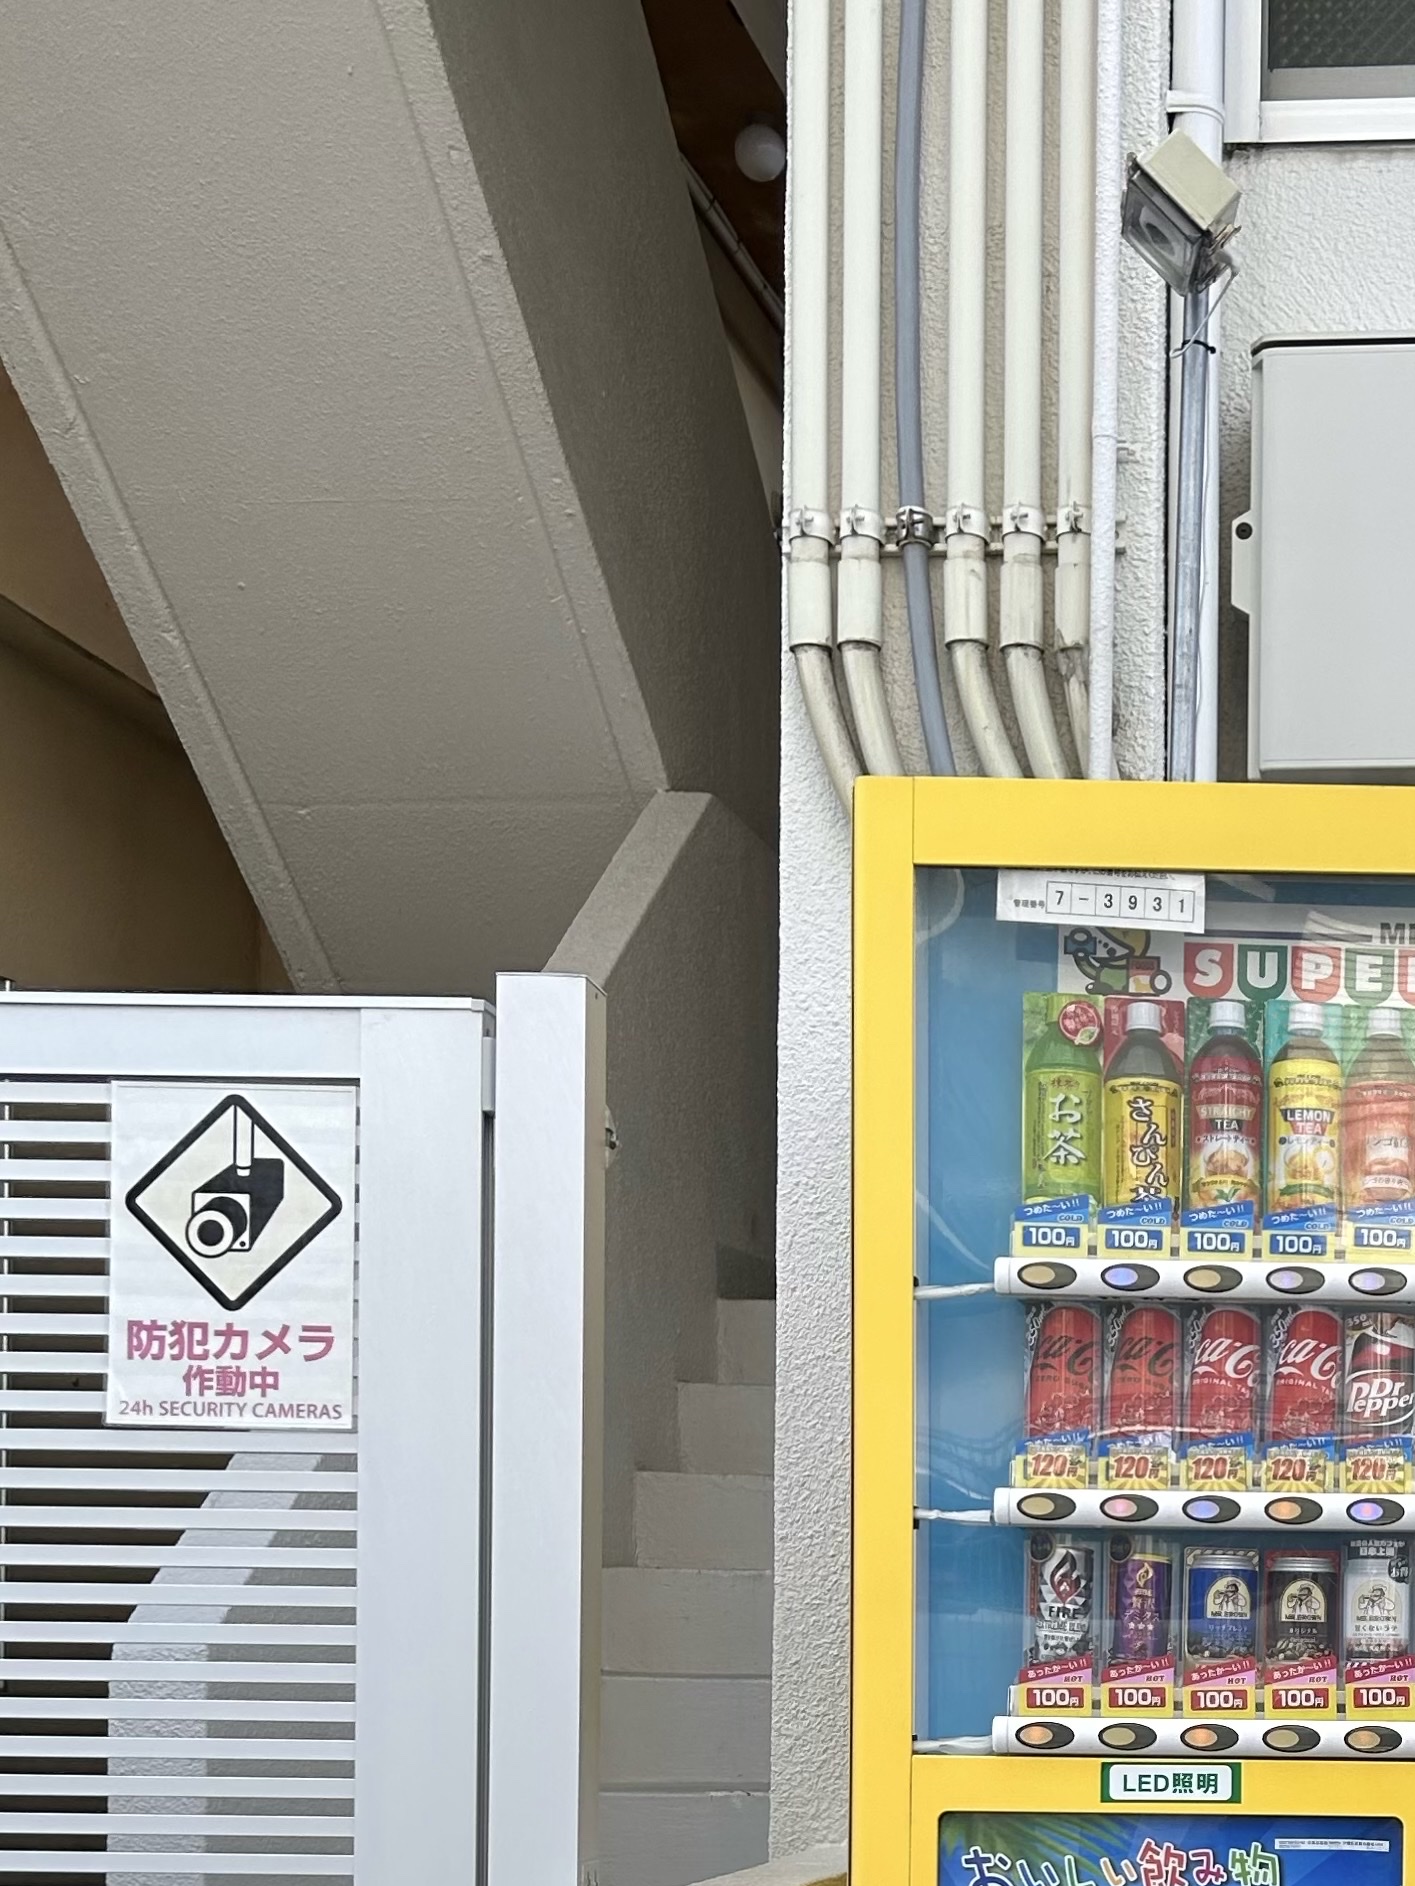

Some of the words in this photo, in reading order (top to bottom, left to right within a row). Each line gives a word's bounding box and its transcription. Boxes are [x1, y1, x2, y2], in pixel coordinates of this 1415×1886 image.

[1199, 1105, 1252, 1119] STRAIGHT
[1286, 1109, 1332, 1121] LEMON
[1043, 1093, 1086, 1165] お茶
[1214, 1119, 1239, 1131] TEA
[1294, 1123, 1322, 1134] TEA
[1127, 1096, 1170, 1202] さんぴん茶
[1058, 1213, 1084, 1224] COLD
[1140, 1216, 1167, 1226] COLD
[1223, 1219, 1248, 1229] COLD
[1305, 1221, 1331, 1231] COLD
[1389, 1216, 1415, 1226] COLD
[1028, 1227, 1076, 1248] 100円
[1111, 1229, 1159, 1249] 100円
[1193, 1232, 1241, 1253] 100円
[1275, 1234, 1323, 1255] 100円
[1359, 1228, 1406, 1249] 100円
[126, 1319, 336, 1362] 防犯カメラ
[181, 1365, 280, 1398] 作動中
[1370, 1377, 1406, 1400] Dr
[118, 1400, 154, 1417] 24h
[158, 1400, 248, 1419] SECURITY
[251, 1402, 343, 1420] CAMERAS
[1031, 1453, 1079, 1478] 120円
[1113, 1454, 1160, 1480] 120円
[1192, 1456, 1240, 1481] 120円
[1270, 1457, 1317, 1482] 120円
[1350, 1456, 1397, 1482] 120円
[1048, 1605, 1079, 1619] FIRE
[1124, 1610, 1160, 1623] デミタス
[1063, 1675, 1084, 1683] HOT
[1145, 1675, 1166, 1683] HOT
[1226, 1676, 1247, 1685] HOT
[1308, 1675, 1328, 1684] HOT
[1389, 1674, 1410, 1683] HOT
[1032, 1688, 1080, 1708] 100円
[1114, 1688, 1161, 1707] 100円
[1196, 1691, 1244, 1709] 100円
[1278, 1689, 1325, 1708] 100円
[1358, 1688, 1406, 1707] 100円
[1121, 1771, 1220, 1795] LED照明
